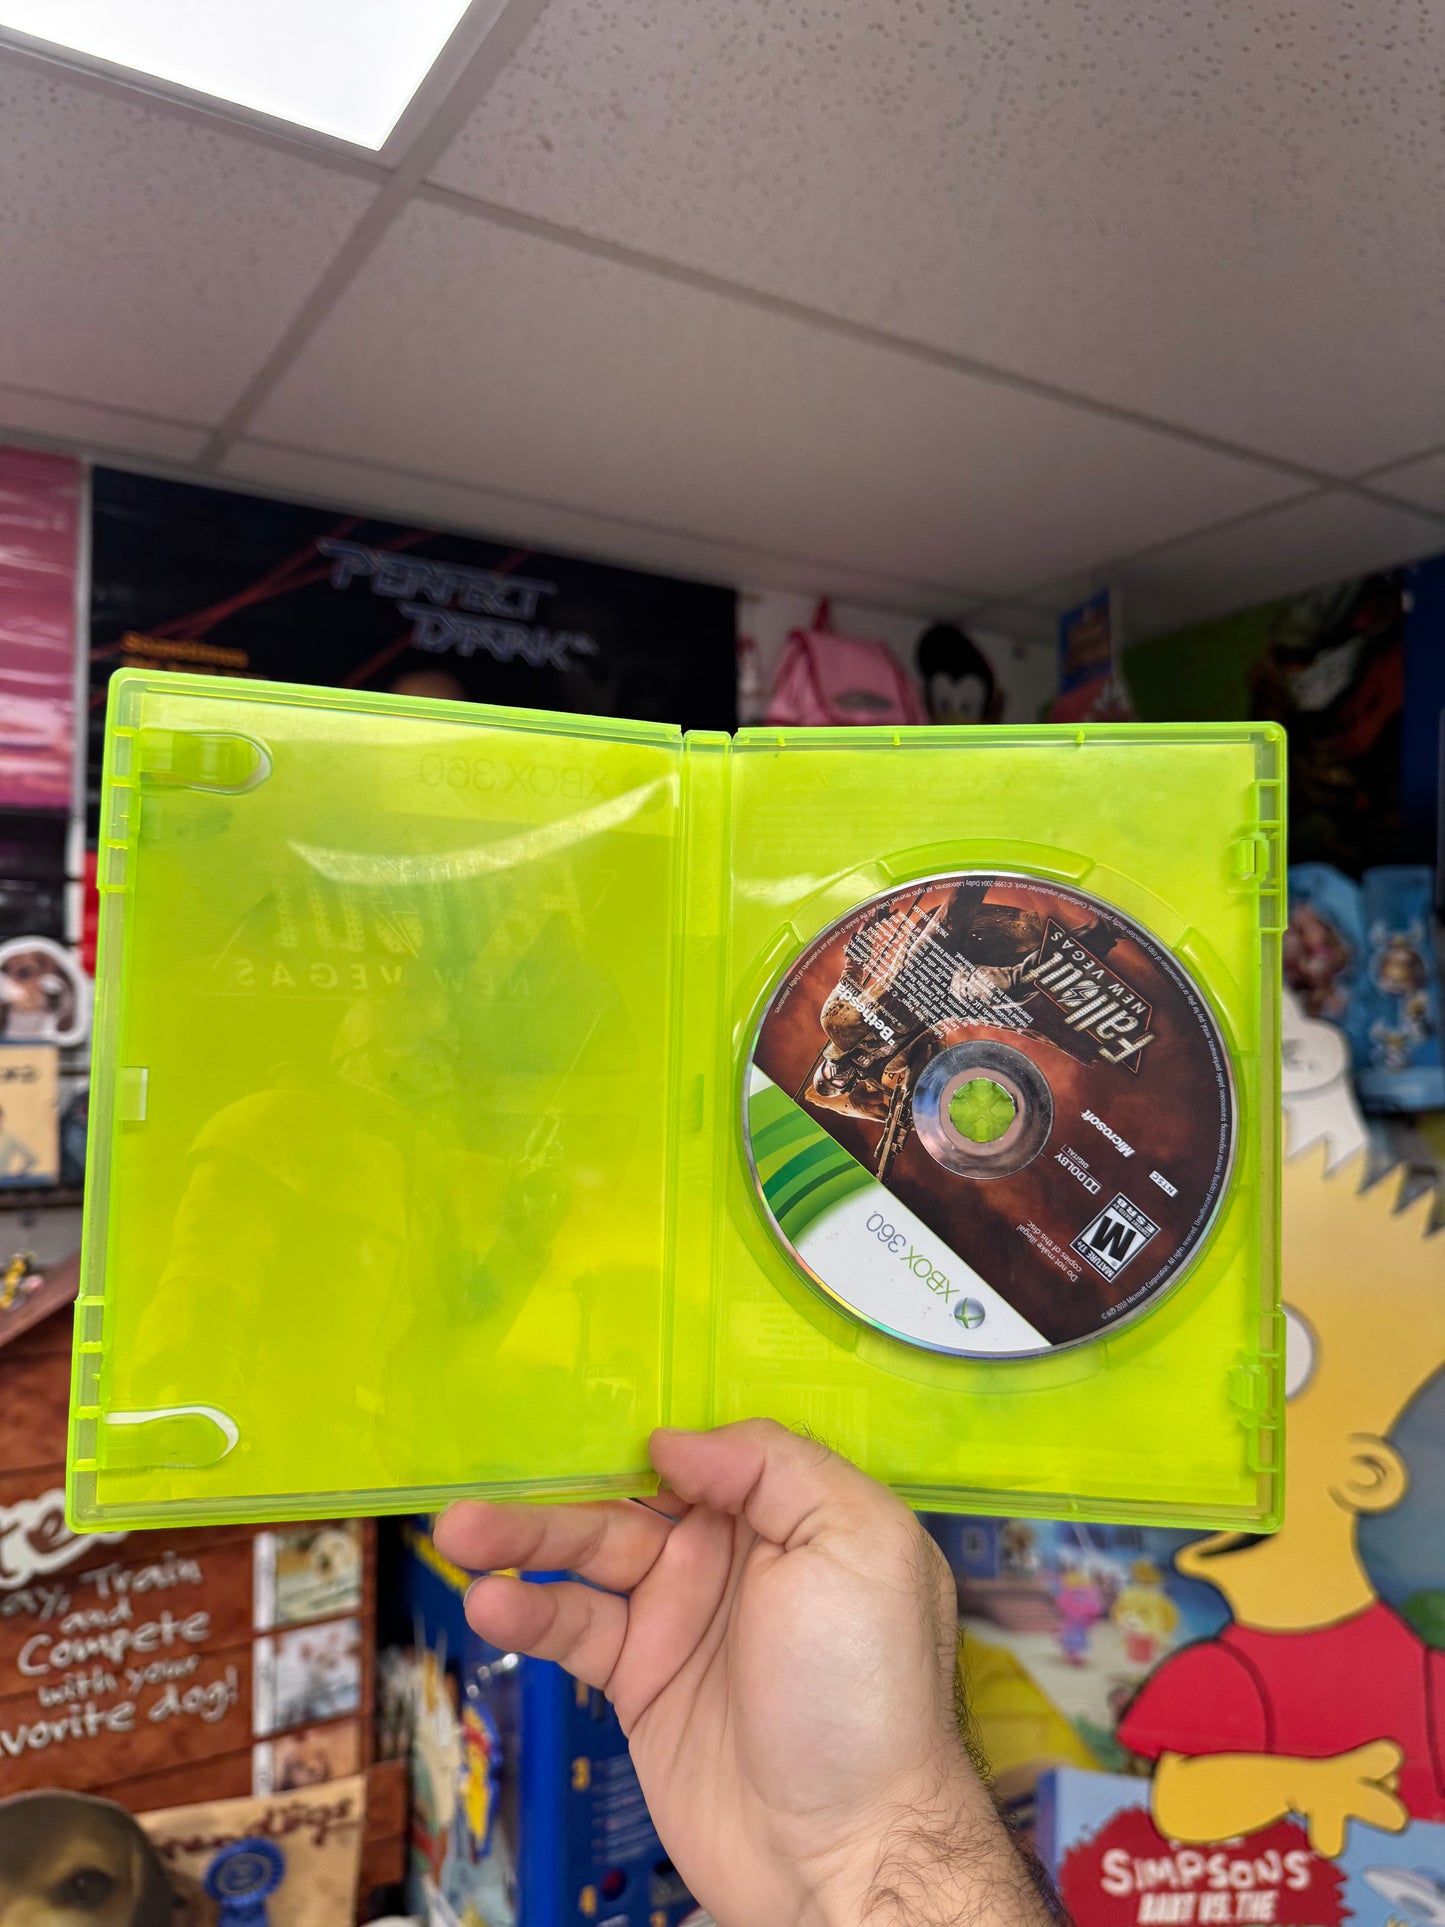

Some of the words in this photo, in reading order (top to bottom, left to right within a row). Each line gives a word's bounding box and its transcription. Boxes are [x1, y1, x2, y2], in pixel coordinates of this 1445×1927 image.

[314, 535, 557, 620] PERFECT
[910, 886, 925, 897] rights
[965, 879, 979, 887] Dolby
[1027, 884, 1058, 898] unpublished
[1057, 892, 1088, 909] Confidential
[866, 925, 883, 942] related
[1125, 927, 1149, 948] protection
[852, 934, 878, 958] trademarks
[1049, 928, 1105, 980] VEGAS
[922, 954, 937, 968] other
[928, 949, 959, 978] Entertainment
[953, 950, 976, 972] Reserved.
[787, 973, 801, 988] Dolby
[897, 973, 906, 982] are
[901, 967, 917, 982] Media
[919, 961, 943, 984] registered
[934, 964, 952, 982] and/or
[903, 978, 919, 993] logos
[914, 979, 935, 998] ZeniMax
[940, 980, 947, 988] or
[993, 986, 1004, 997] Inc.
[905, 992, 920, 1007] Media
[915, 990, 932, 1007] related
[931, 995, 939, 1003] of
[971, 998, 982, 1009] LLC
[991, 995, 1001, 1004] are
[1107, 978, 1147, 1016] NEW
[830, 981, 895, 1041] Bethesda
[918, 1004, 938, 1023] ZeniMax
[930, 1004, 941, 1015] and
[1018, 950, 1156, 1064] Fallout
[1010, 1012, 1028, 1029] related
[1215, 1071, 1225, 1087] public
[1079, 1106, 1135, 1159] Microsoft
[1053, 1150, 1087, 1182] DOLBY
[1065, 1146, 1089, 1169] DIGITAL
[1150, 1171, 1175, 1194] NTSC
[1115, 1196, 1155, 1233] ESRB
[1117, 1206, 1133, 1221] RATED
[862, 1210, 909, 1255] 360
[1015, 1222, 1038, 1244] illegal
[1023, 1219, 1041, 1236] disc.
[1130, 1218, 1151, 1237] CONTENT
[1038, 1232, 1053, 1247] this
[1074, 1239, 1088, 1253] 17+
[1088, 1214, 1136, 1261] M
[1035, 1240, 1055, 1260] make
[1051, 1244, 1061, 1254] of
[1053, 1257, 1066, 1270] not
[1058, 1250, 1083, 1273] copies
[1085, 1249, 1115, 1277] MATURE
[897, 1244, 961, 1304] XBOX
[1063, 1267, 1078, 1282] Do
[1125, 1284, 1148, 1304] Microsoft
[79, 1551, 203, 1598] Train
[60, 1596, 133, 1634] and
[17, 1610, 210, 1676] Compete
[38, 1665, 118, 1707] with
[124, 1653, 201, 1694] your
[0, 1700, 136, 1757] vorite
[149, 1665, 239, 1723] dog!
[1100, 1848, 1312, 1897] SIMPSONS
[1236, 1890, 1279, 1922] THE
